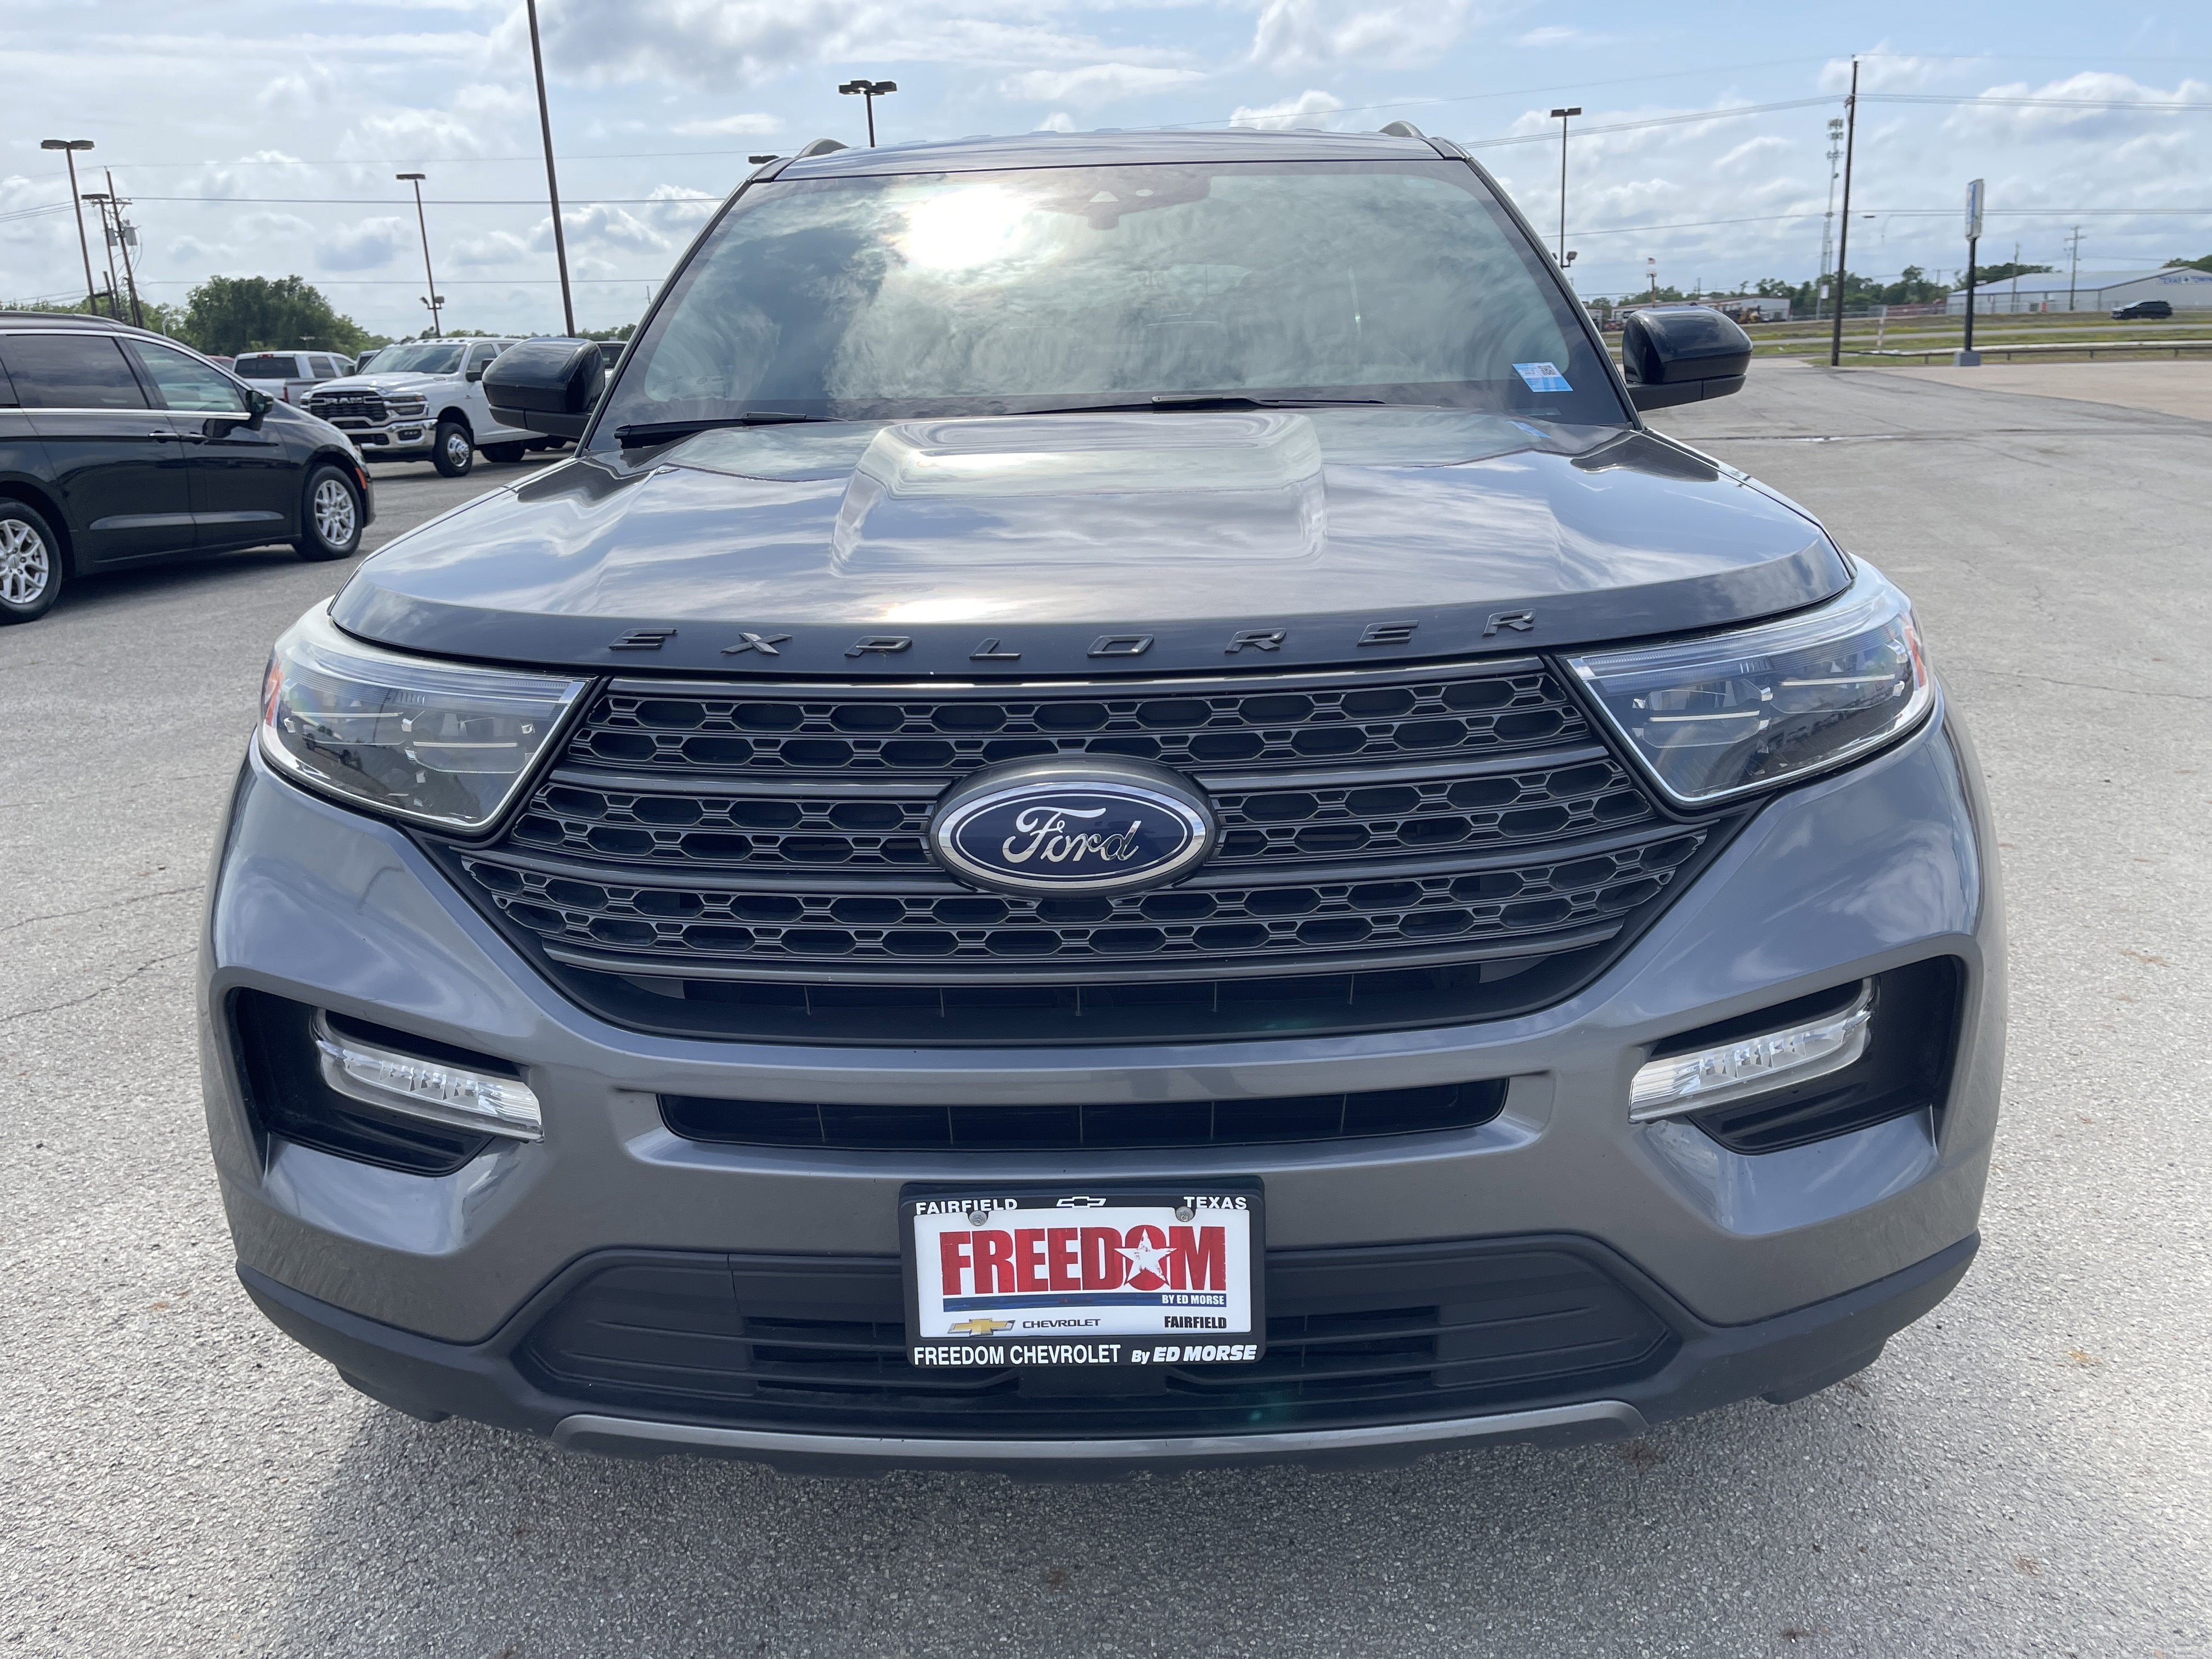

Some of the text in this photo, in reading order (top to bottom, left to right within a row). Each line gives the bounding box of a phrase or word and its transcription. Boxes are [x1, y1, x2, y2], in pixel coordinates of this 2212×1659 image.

[608, 608, 1536, 660] EXPLORER
[1002, 805, 1142, 864] Ford
[916, 1198, 1018, 1215] FAIRFIELD
[1183, 1196, 1247, 1210] TEXAS
[939, 1224, 1227, 1295] FREEDOM
[1162, 1294, 1224, 1305] BY ED MORSE
[1022, 1318, 1101, 1328] CHEVROLET
[1164, 1316, 1227, 1329] FAIRFIELD
[914, 1344, 1257, 1365] FREEDOM CHEVROLET By ED MORSE
